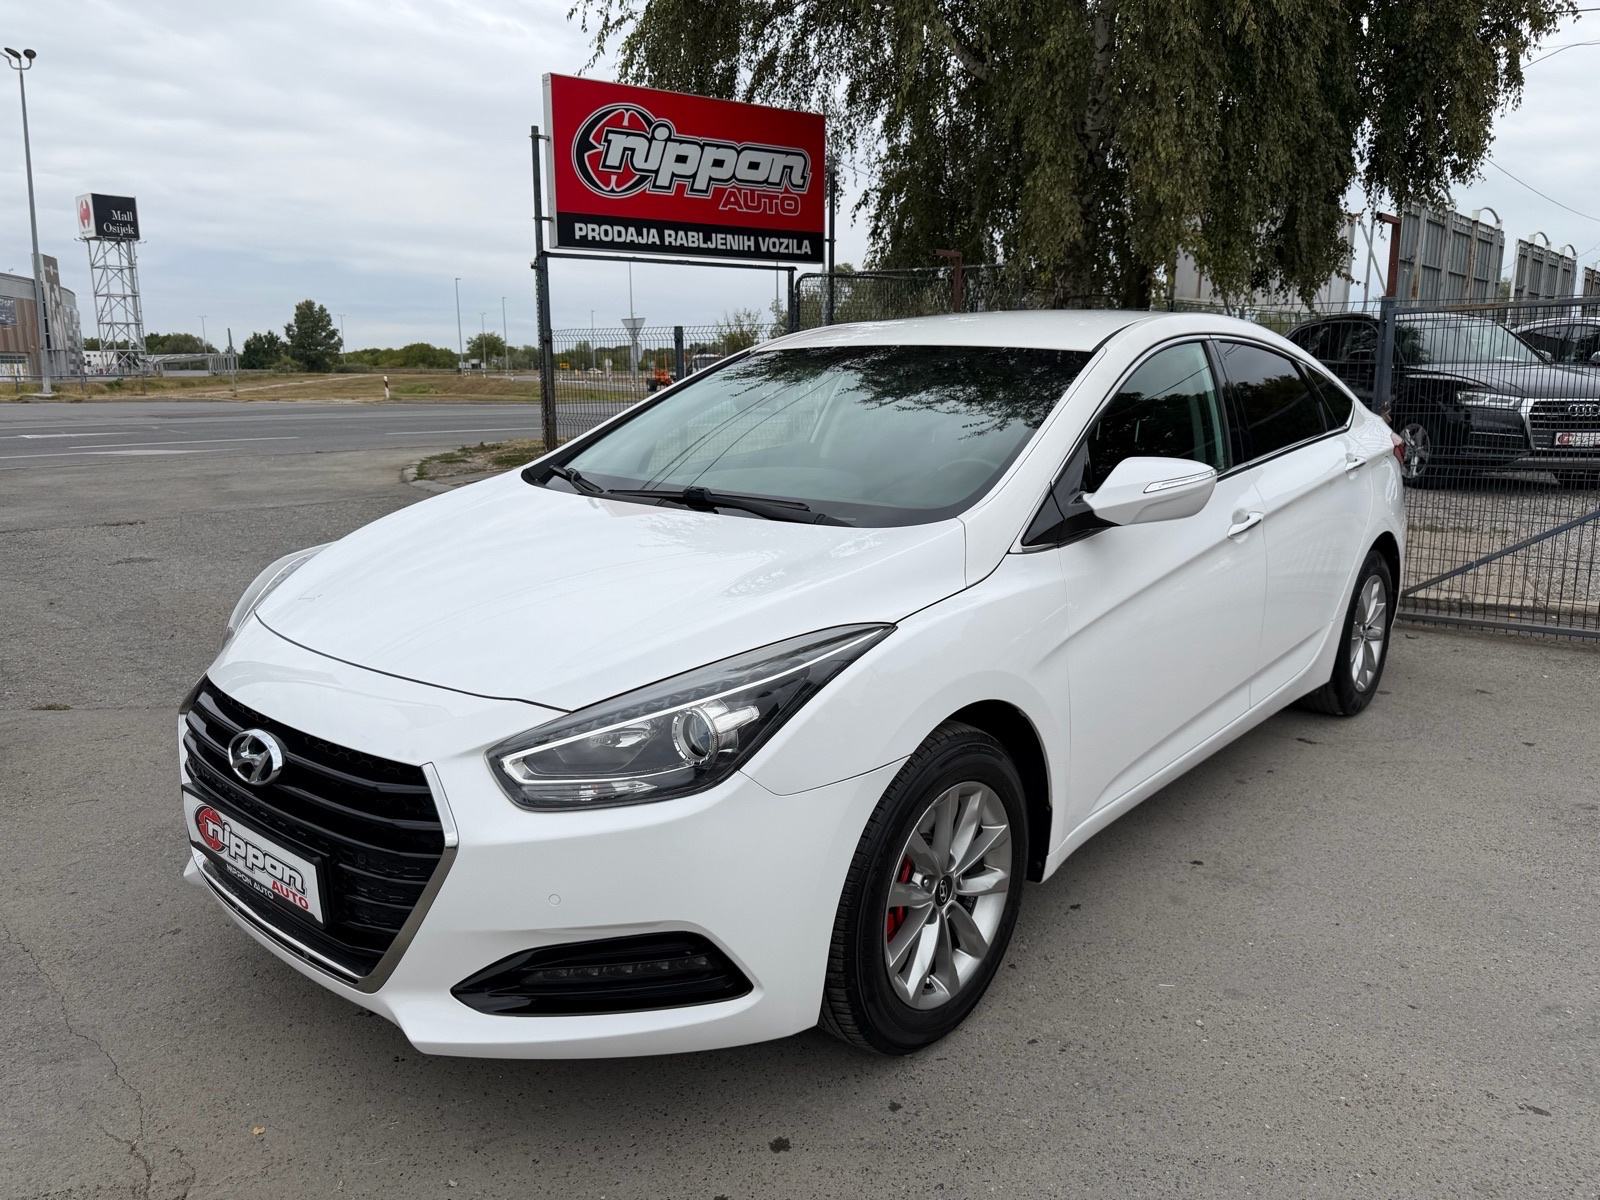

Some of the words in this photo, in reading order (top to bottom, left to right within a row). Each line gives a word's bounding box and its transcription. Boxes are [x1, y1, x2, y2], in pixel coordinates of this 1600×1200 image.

[603, 125, 808, 192] nippon
[111, 210, 134, 222] Mall
[719, 189, 801, 216] AUTO
[103, 221, 135, 236] Osijek
[574, 222, 661, 245] PRODAJA
[664, 229, 756, 252] RABLJENIH
[758, 236, 812, 255] VOZILA
[204, 818, 306, 896] nippon
[253, 881, 274, 899] AUTO
[271, 879, 309, 910] AUTO
